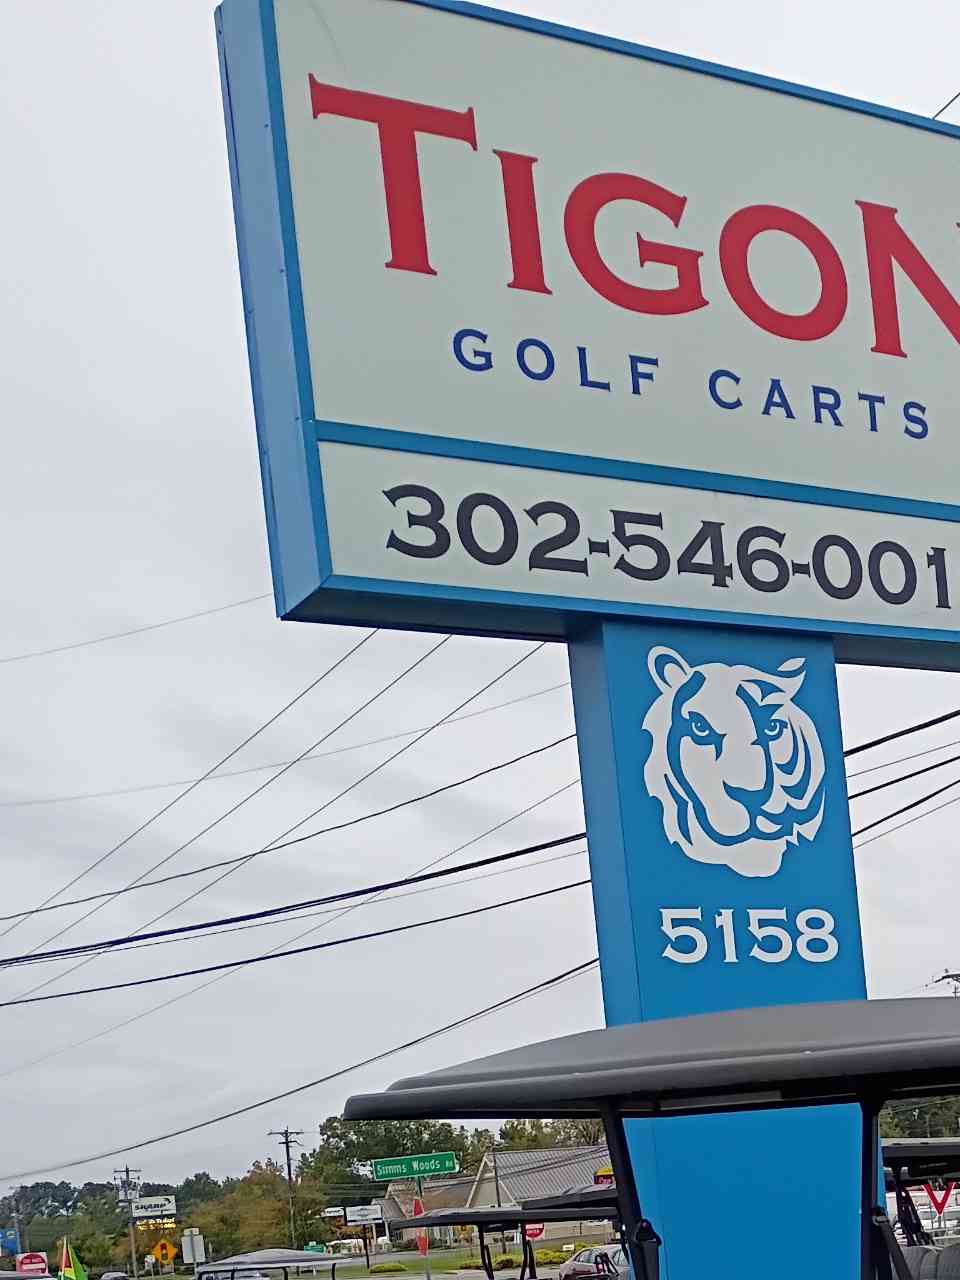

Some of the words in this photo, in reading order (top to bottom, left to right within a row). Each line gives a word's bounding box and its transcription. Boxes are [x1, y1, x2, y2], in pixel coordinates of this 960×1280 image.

[452, 328, 659, 395] GOLF
[708, 368, 930, 440] CARTS
[659, 906, 840, 964] 5158
[411, 1158, 441, 1171] Woods
